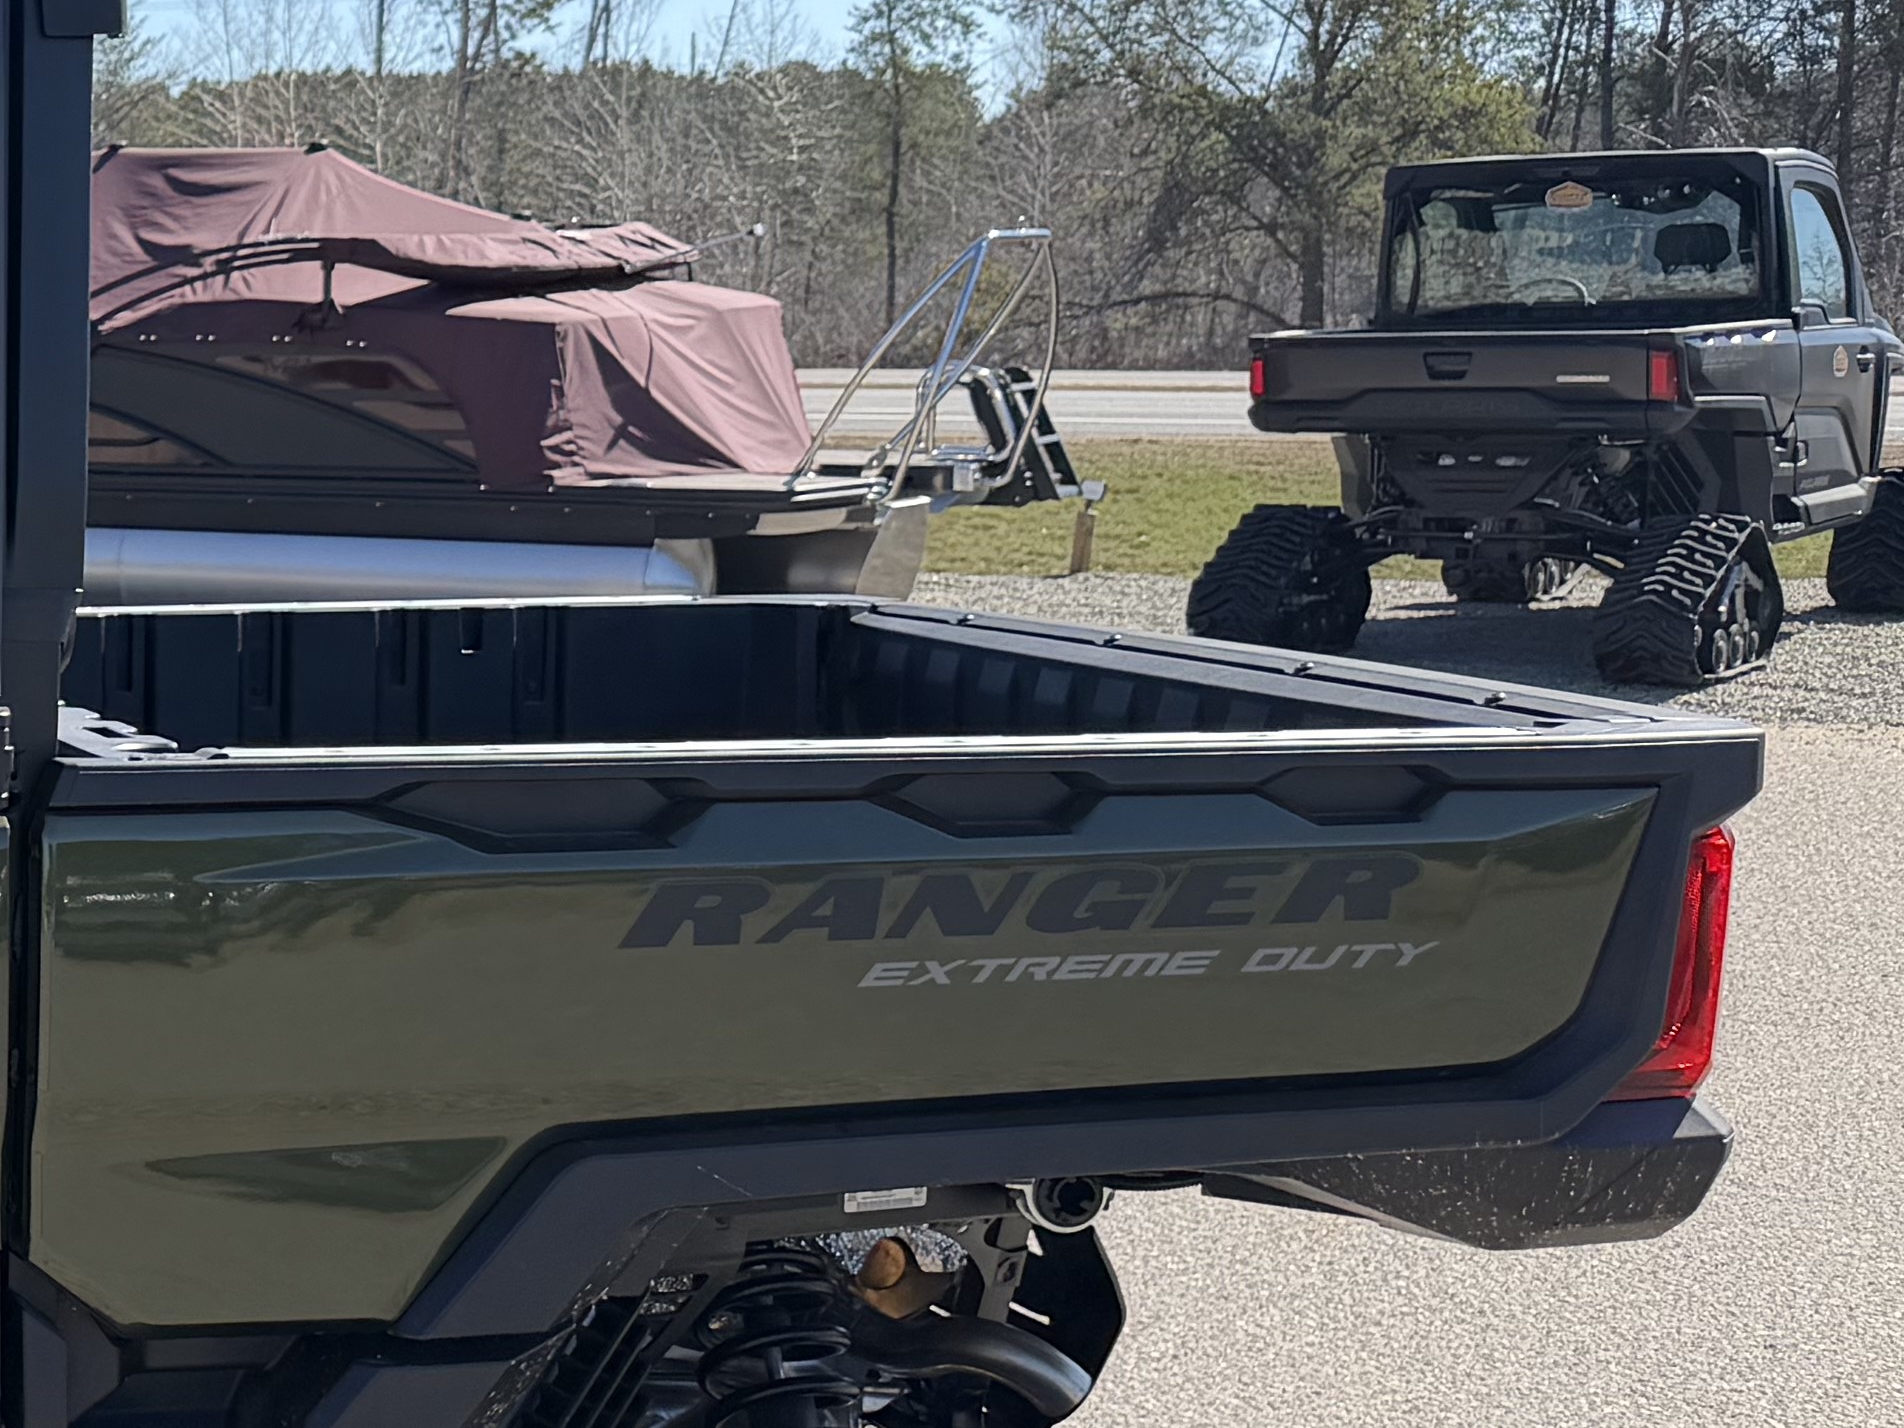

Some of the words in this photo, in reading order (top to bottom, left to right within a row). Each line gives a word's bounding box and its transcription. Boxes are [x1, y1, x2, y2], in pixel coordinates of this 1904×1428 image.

[618, 854, 1422, 949] RANGER
[856, 948, 1221, 988] EXTREME
[1240, 939, 1440, 974] DUTY
